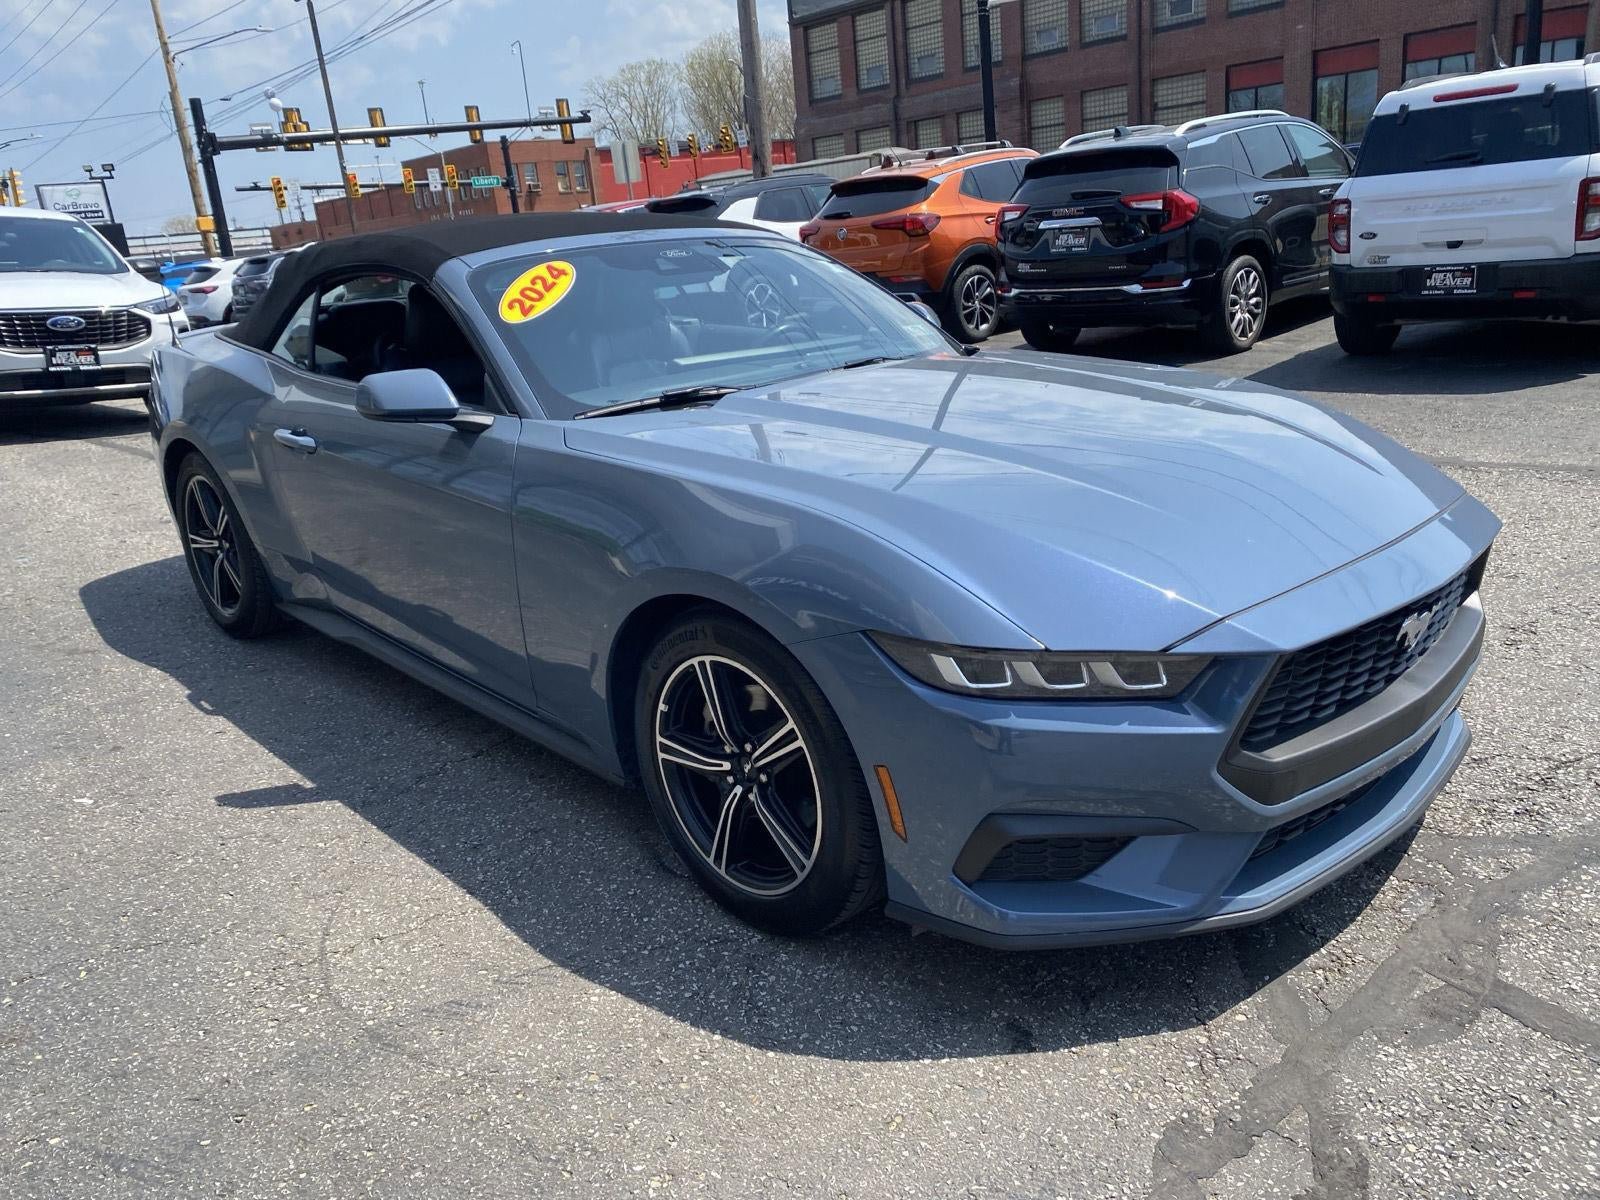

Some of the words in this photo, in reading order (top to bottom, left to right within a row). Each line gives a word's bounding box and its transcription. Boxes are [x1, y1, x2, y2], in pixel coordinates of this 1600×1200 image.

[475, 178, 497, 186] Liberty
[53, 201, 100, 211] CarBravo
[1426, 277, 1472, 287] WEAVER
[507, 262, 569, 318] 2024
